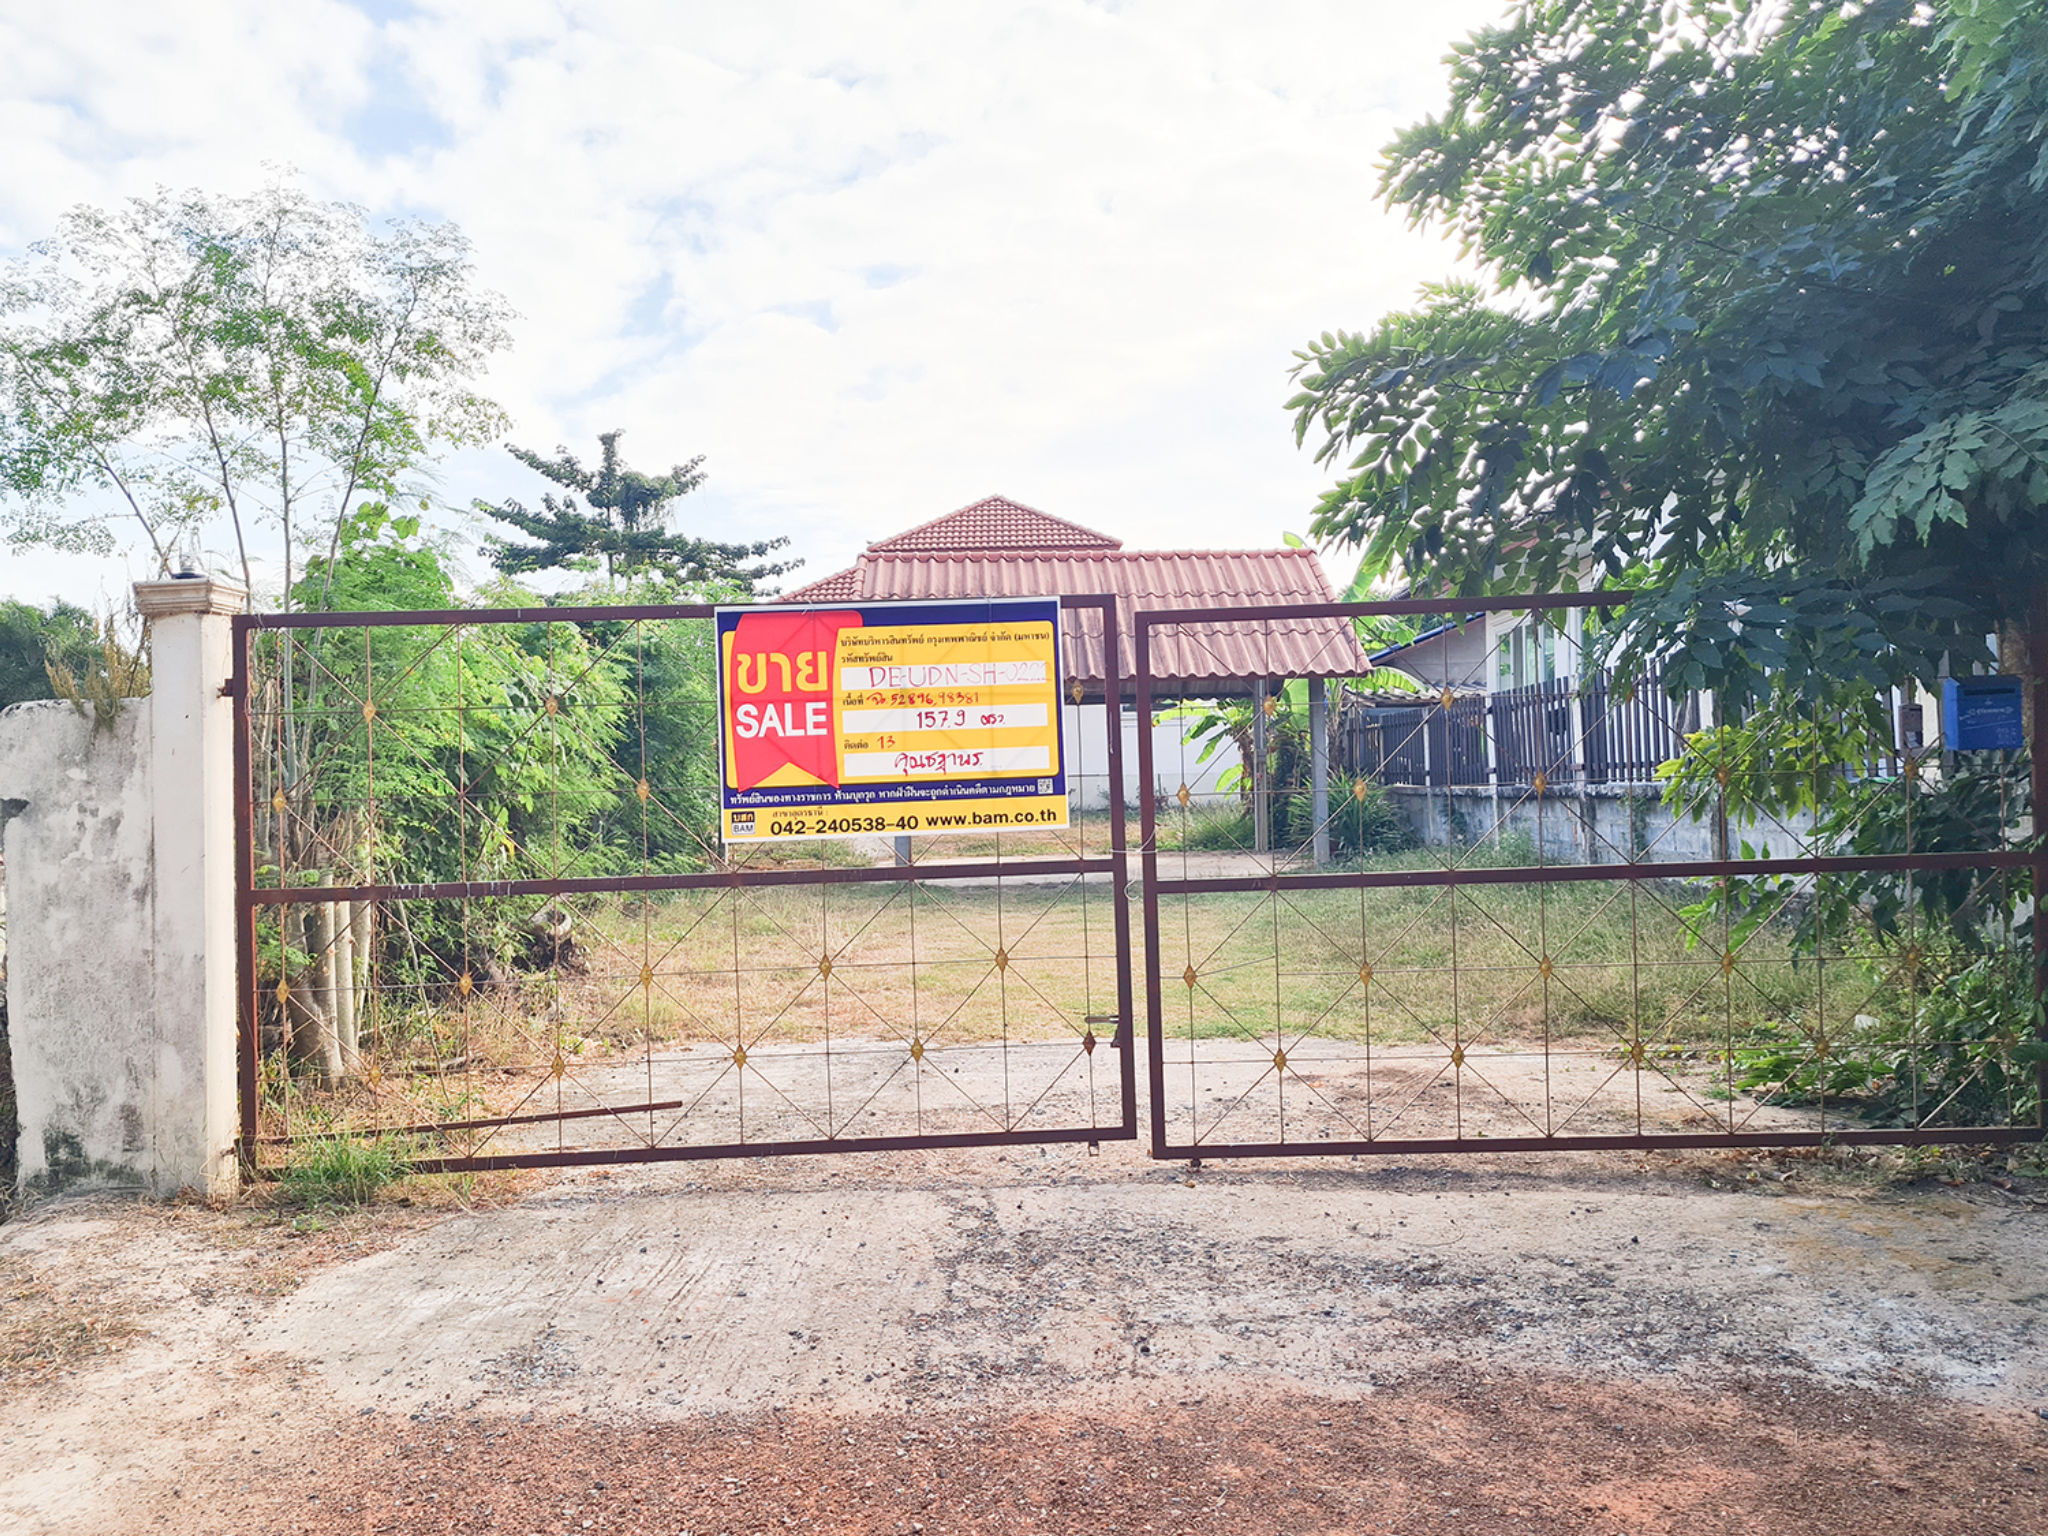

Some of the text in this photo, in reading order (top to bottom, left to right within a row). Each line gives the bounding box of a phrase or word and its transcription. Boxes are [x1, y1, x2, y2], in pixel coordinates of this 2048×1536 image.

[841, 631, 1050, 648] บริษัทบริหารสินทรัพย์ กรุงเทพพาณิชย์ จำกัด (มหาชน)
[841, 653, 893, 664] รหัสทรัพย์สิน
[737, 651, 828, 694] ขาย
[842, 692, 864, 705] เนื้อที่
[736, 702, 828, 738] SALE
[843, 738, 870, 750] ติดต่อ
[730, 790, 832, 806] ทรัพย์สินของทางราชการ
[834, 789, 876, 804] ห้ามบุกรุก
[733, 824, 754, 833] BAM
[770, 809, 1057, 836] 042-240538-40 www.bam.co.th
